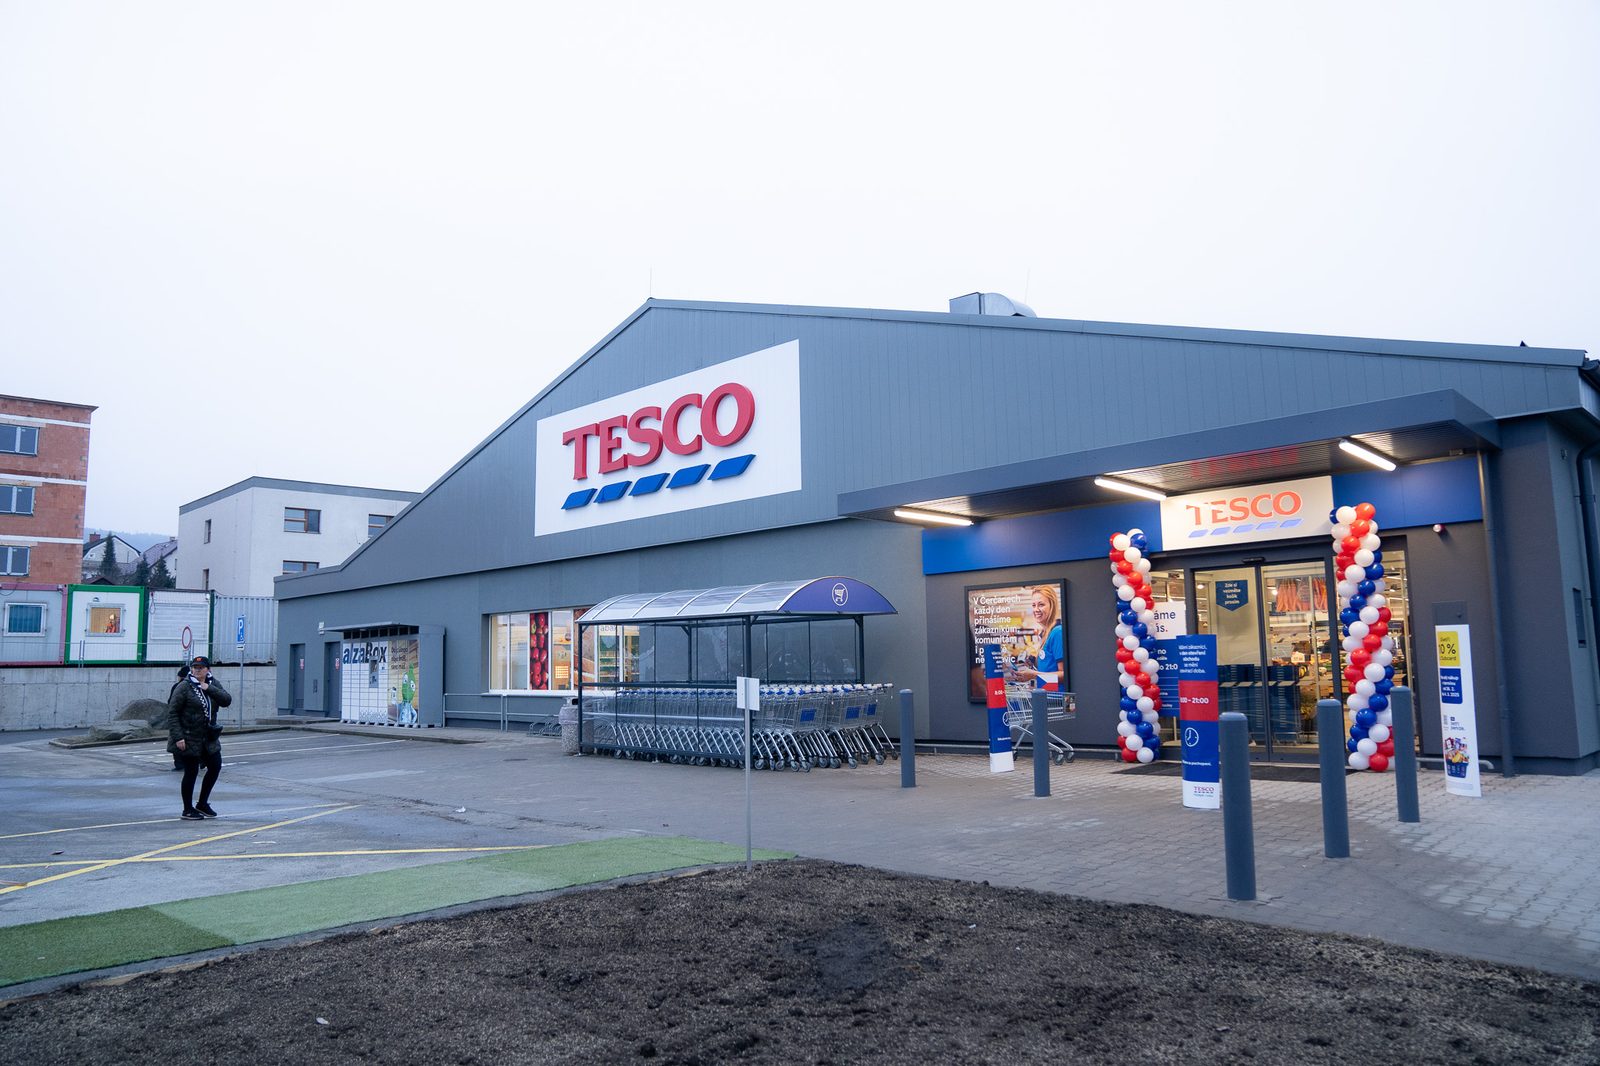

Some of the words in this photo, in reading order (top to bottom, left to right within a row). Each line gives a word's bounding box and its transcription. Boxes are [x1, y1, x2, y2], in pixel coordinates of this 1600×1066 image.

[562, 382, 756, 481] TESCO
[1185, 491, 1303, 526] TESCO
[974, 606, 994, 615] každý
[1154, 610, 1176, 620] áme
[974, 615, 1011, 626] přinášíme
[974, 635, 1018, 644] komunitám
[342, 642, 388, 664] alzaBox
